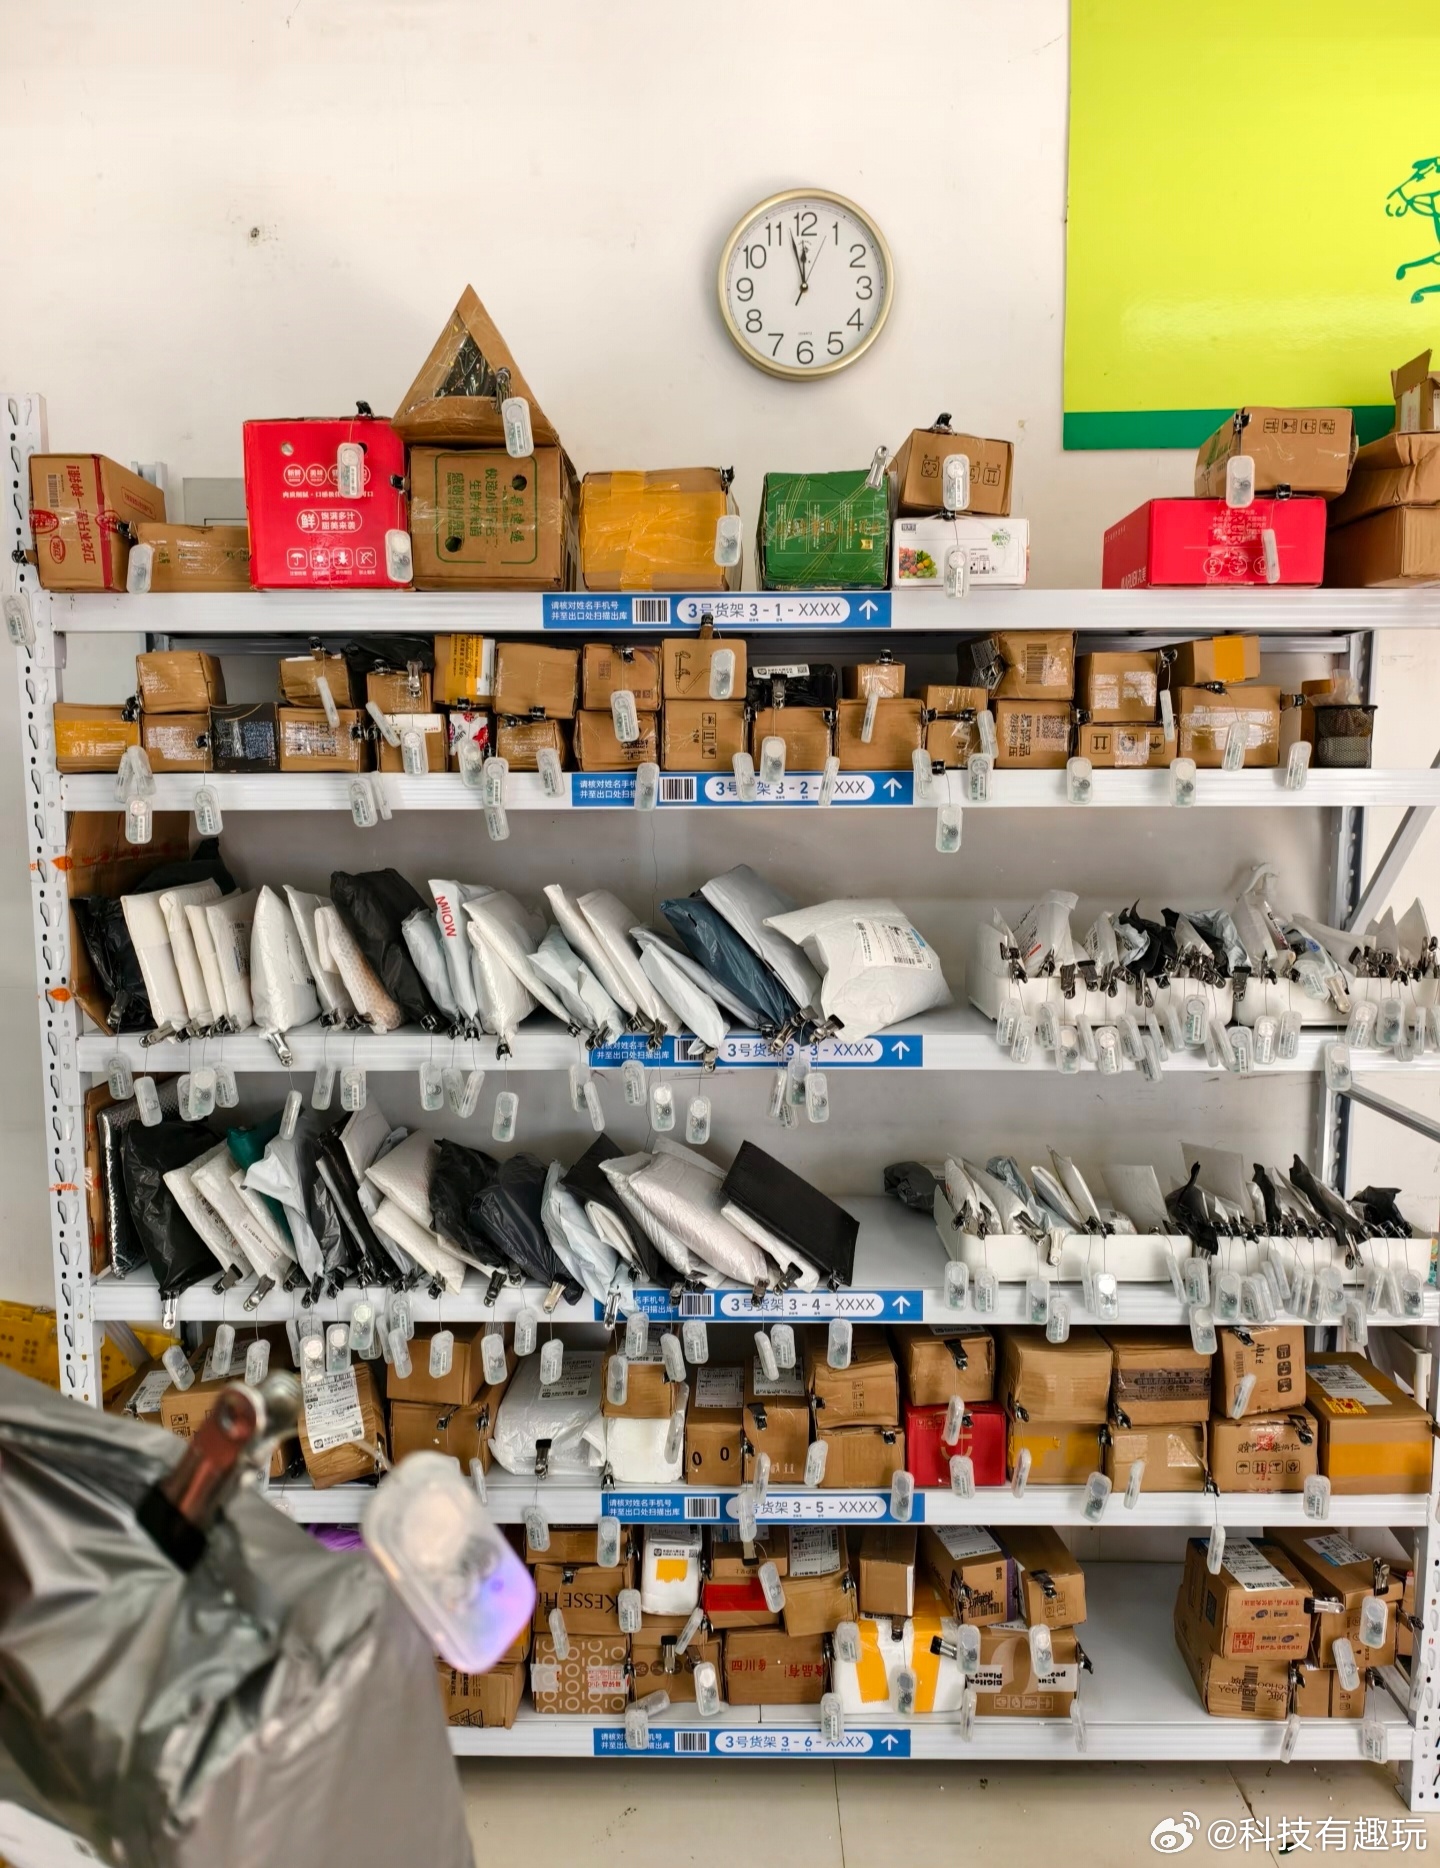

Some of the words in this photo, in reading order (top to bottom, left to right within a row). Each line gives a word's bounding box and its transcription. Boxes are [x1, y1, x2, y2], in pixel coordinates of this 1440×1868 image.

[765, 221, 782, 246] 11
[793, 212, 818, 237] 12
[832, 222, 839, 246] 1
[743, 244, 767, 269] 10
[849, 244, 866, 268] 2
[736, 277, 753, 302] 9
[855, 276, 873, 300] 3
[745, 309, 762, 333] 8
[846, 308, 864, 332] 4
[768, 333, 784, 357] 7
[796, 340, 814, 365] 6
[826, 331, 844, 355] 5
[300, 514, 316, 529] 鲜
[551, 601, 619, 610] 请核对姓名手机号
[551, 611, 628, 621] 并至出口处扫描出库
[715, 782, 771, 796] 3号架
[435, 895, 457, 937] MIIOW
[596, 1051, 670, 1060] 并至出口处扫描出库
[609, 1499, 672, 1507] 请核对姓名手机号
[609, 1508, 681, 1517] 并至出口处扫描出库
[563, 1592, 618, 1613] KESSE
[784, 1663, 824, 1678] 食品有
[725, 1735, 777, 1749] 3号货架
